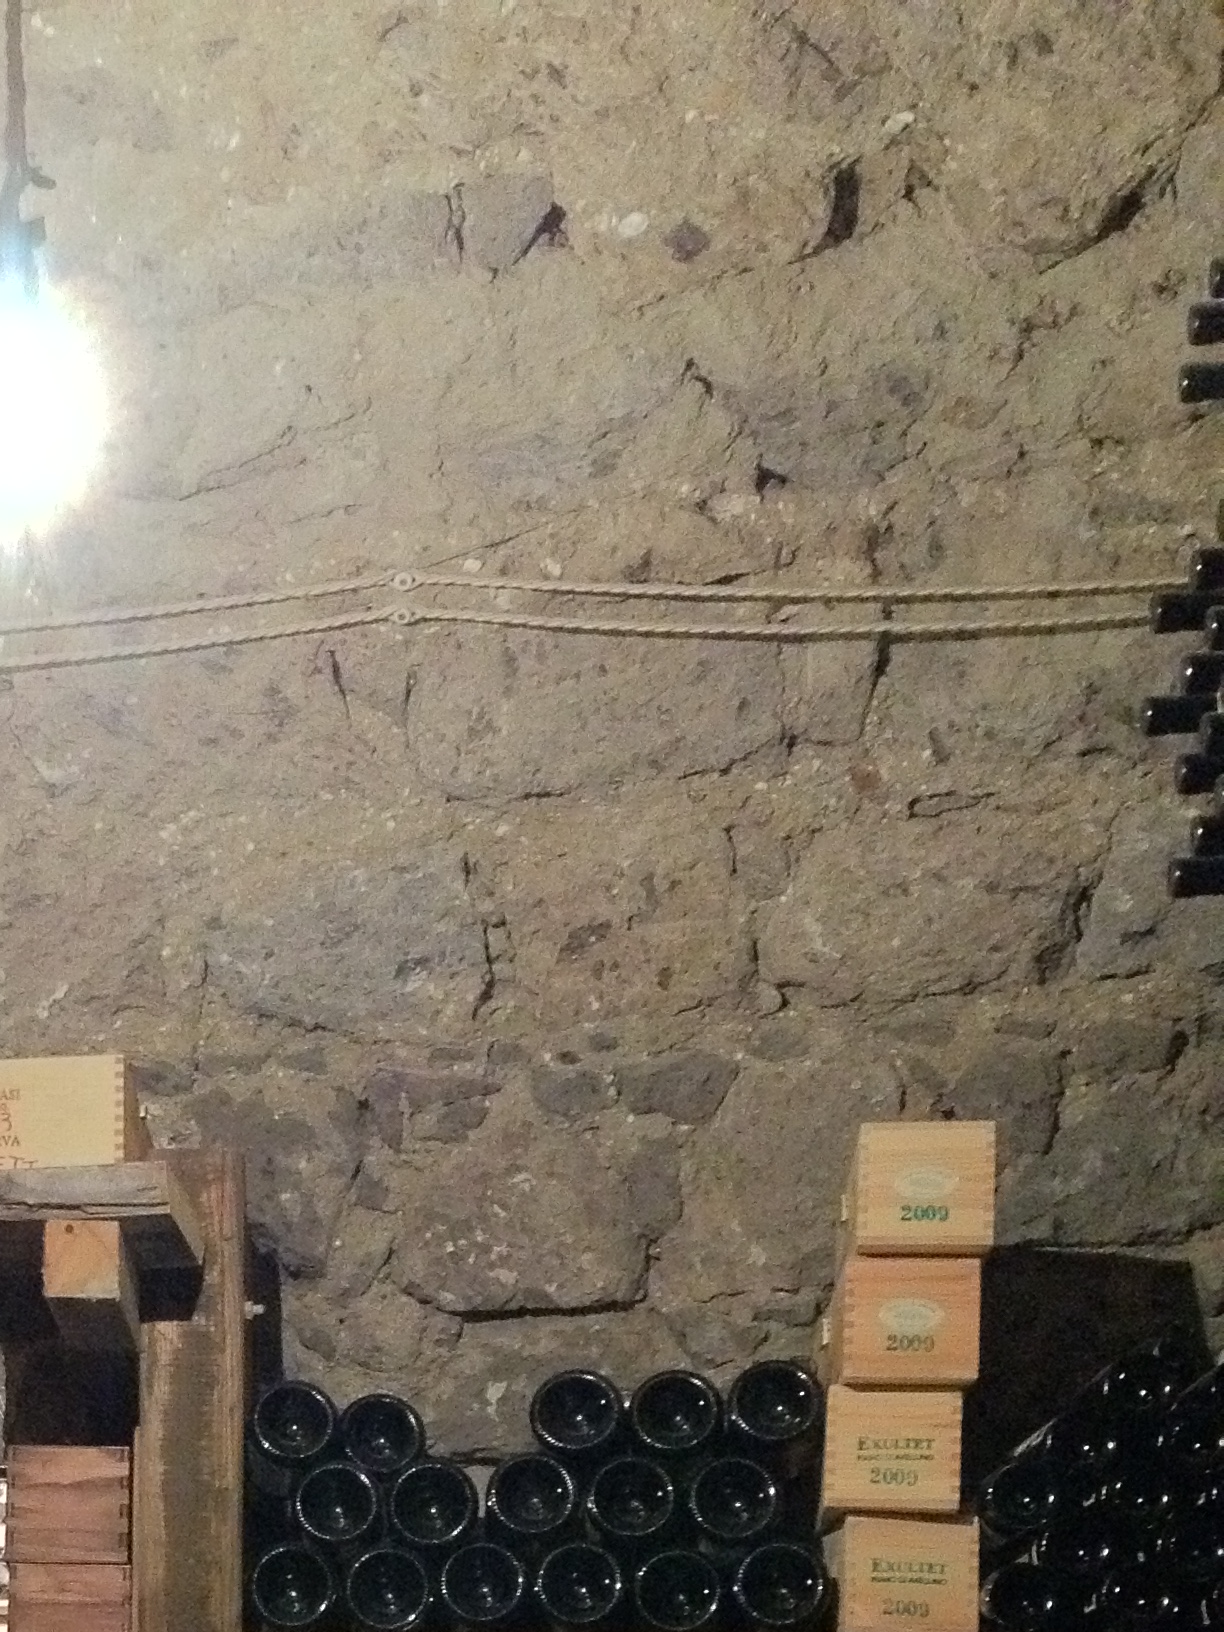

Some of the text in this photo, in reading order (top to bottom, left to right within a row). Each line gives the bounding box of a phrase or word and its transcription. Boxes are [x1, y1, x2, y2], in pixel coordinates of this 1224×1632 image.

[900, 1204, 949, 1222] 2009
[886, 1334, 935, 1353] 2009
[857, 1435, 936, 1451] EXULTET
[869, 1467, 919, 1487] 2009
[882, 1598, 930, 1618] 2009
